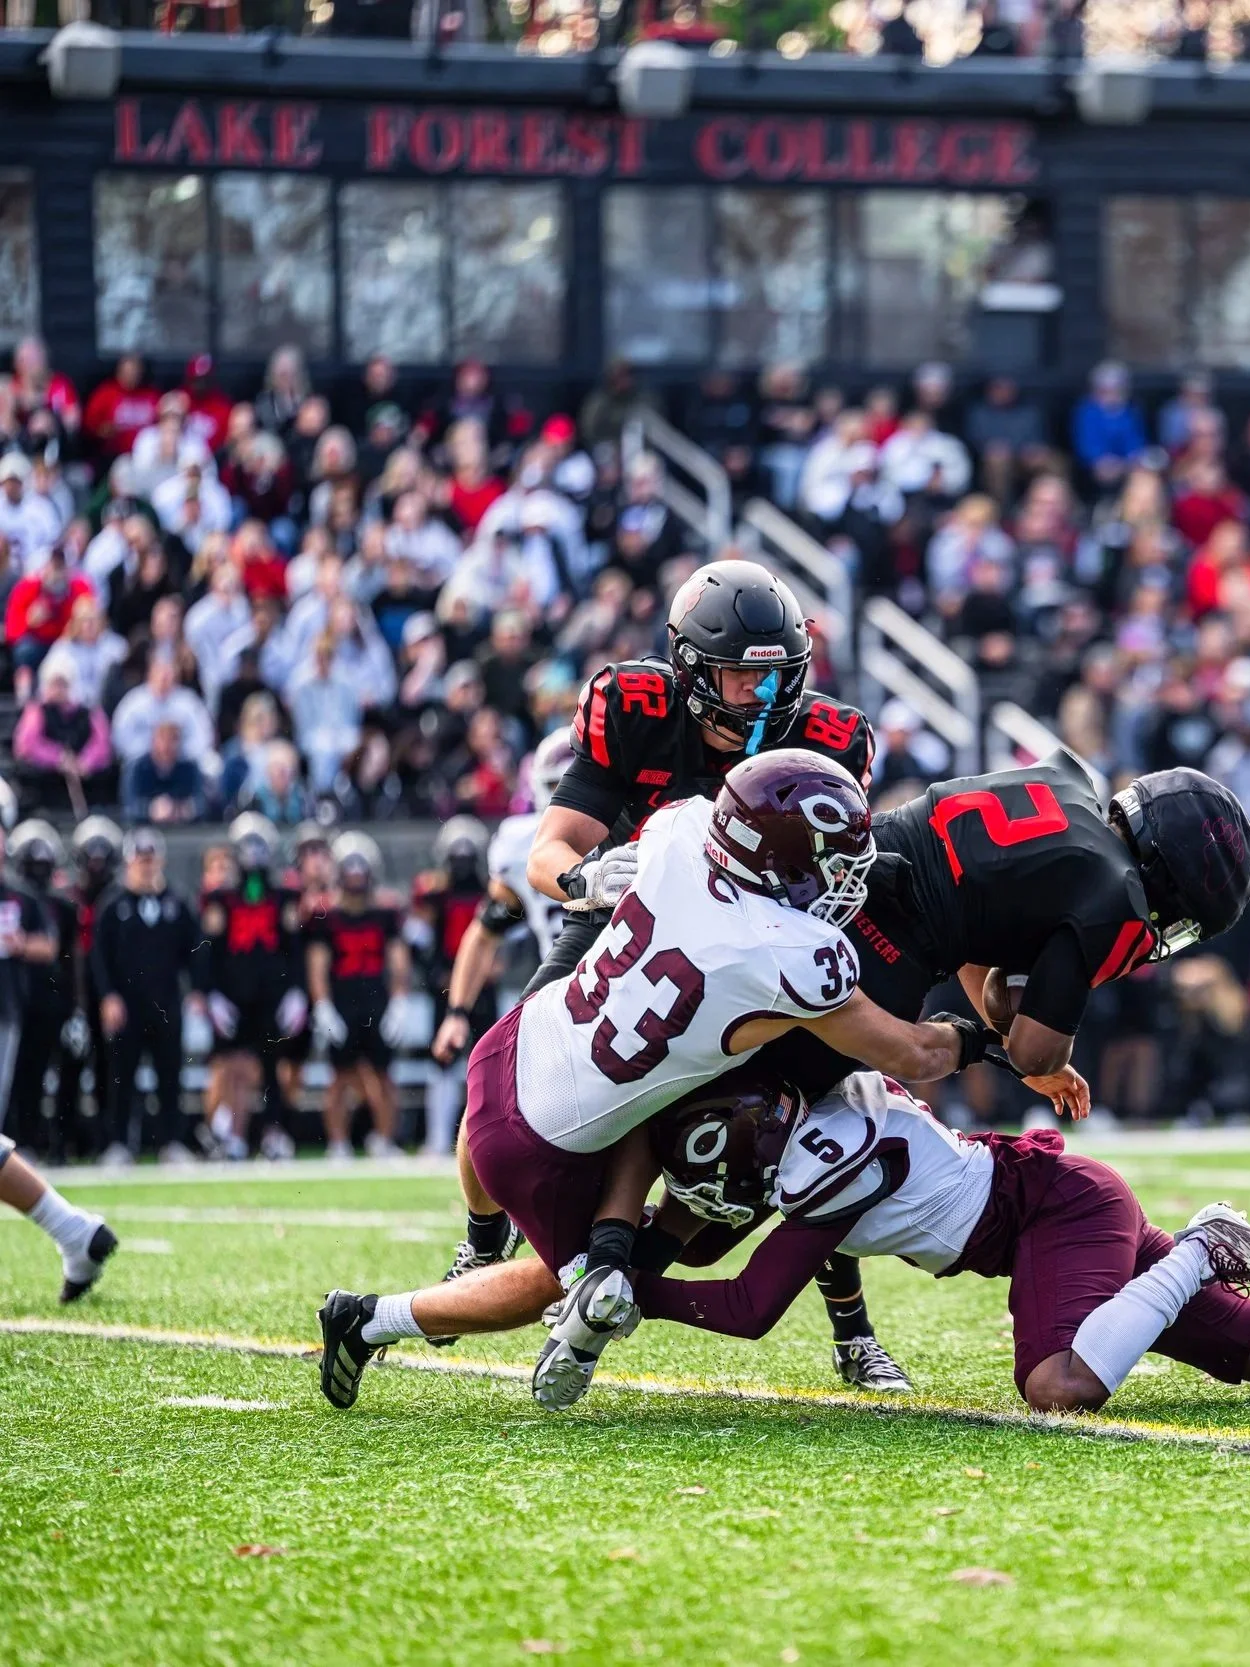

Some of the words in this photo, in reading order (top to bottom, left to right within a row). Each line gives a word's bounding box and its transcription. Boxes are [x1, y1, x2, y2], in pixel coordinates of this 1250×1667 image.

[114, 98, 324, 167] LAKE
[364, 105, 654, 177] FOREST
[695, 115, 1039, 185] COLLEGE
[750, 649, 782, 658] Riddell
[617, 671, 668, 719] 82
[804, 700, 860, 751] 82
[798, 794, 850, 834] C
[928, 783, 1070, 888] 2
[564, 890, 706, 1085] 33
[813, 938, 858, 1002] 33
[686, 1121, 728, 1164] C
[798, 1128, 844, 1164] 5
